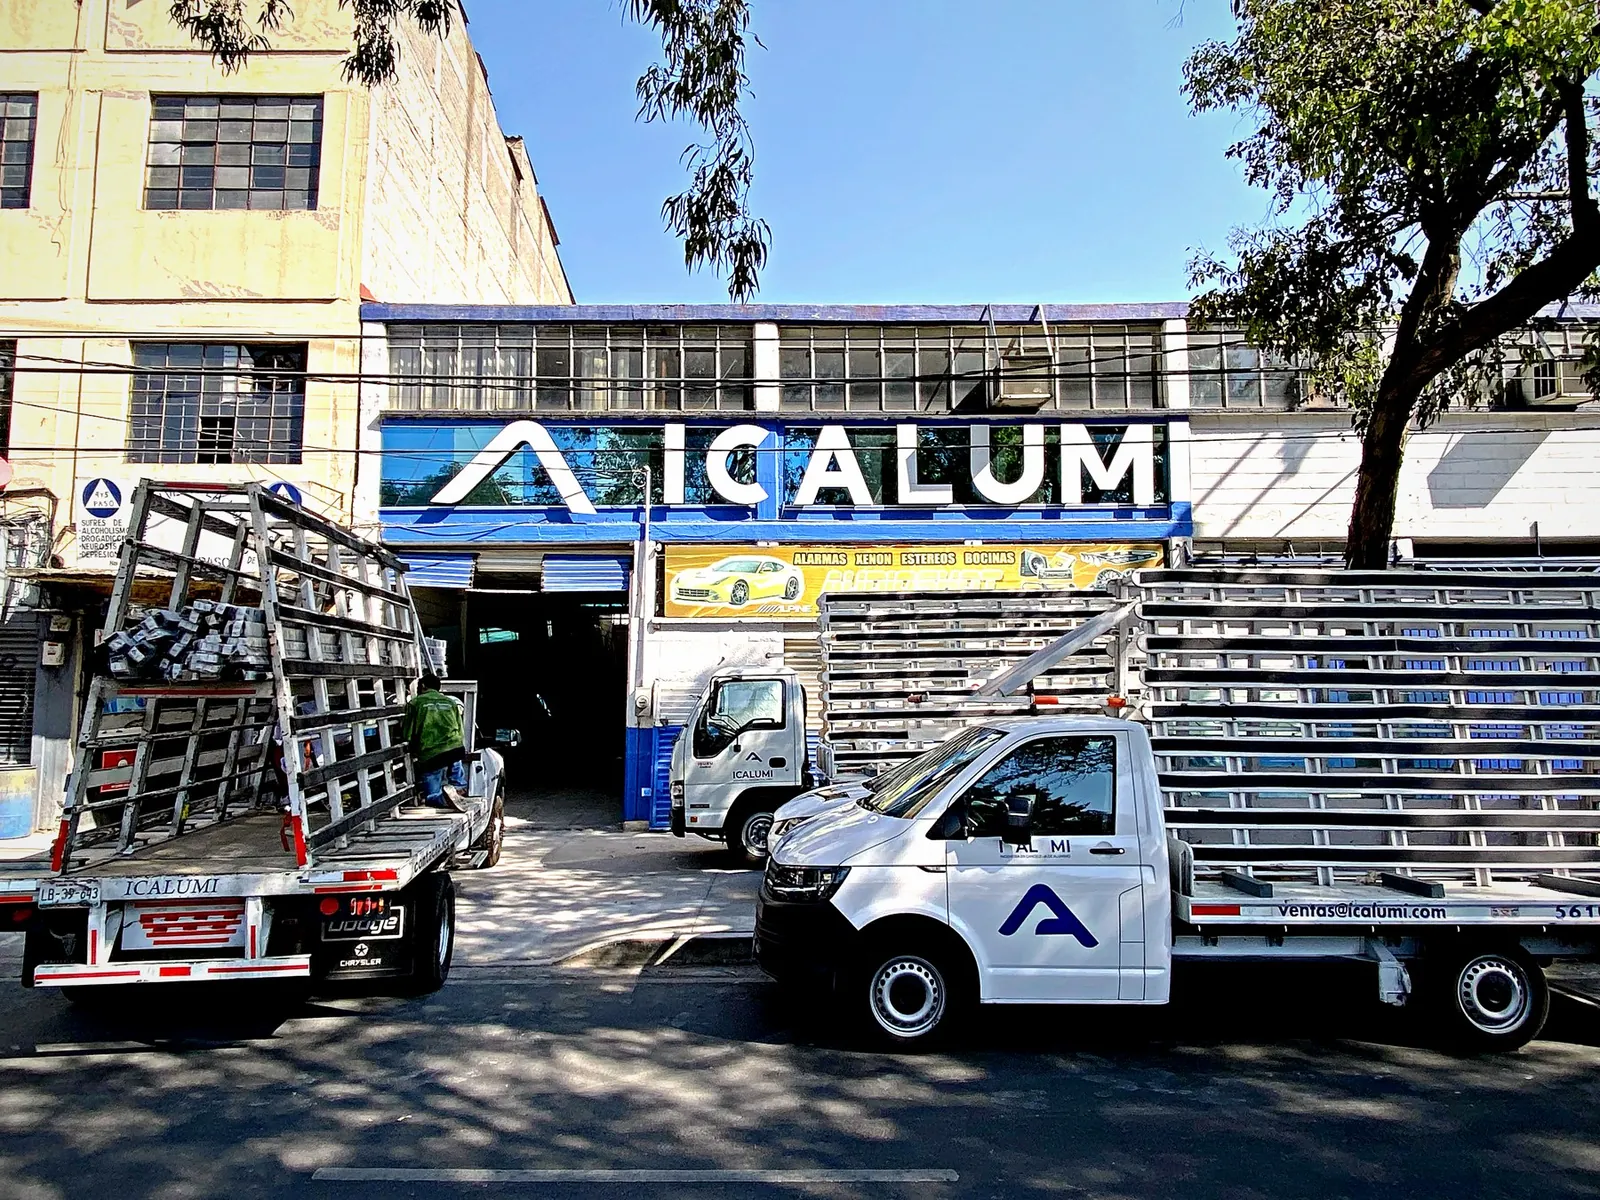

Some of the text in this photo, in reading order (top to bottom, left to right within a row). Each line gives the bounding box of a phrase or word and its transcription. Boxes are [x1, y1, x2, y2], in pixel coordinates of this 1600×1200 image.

[793, 552, 1016, 565] ALARMAS XENON ESTEREOS BOCINAS
[733, 770, 773, 779] ICALUMI
[999, 840, 1070, 853] IALMI
[124, 878, 220, 896] ICALUMI
[1279, 903, 1447, 919] ventas@icalumi.com
[1555, 904, 1600, 919] 561
[340, 957, 382, 967] CHRYSLER
